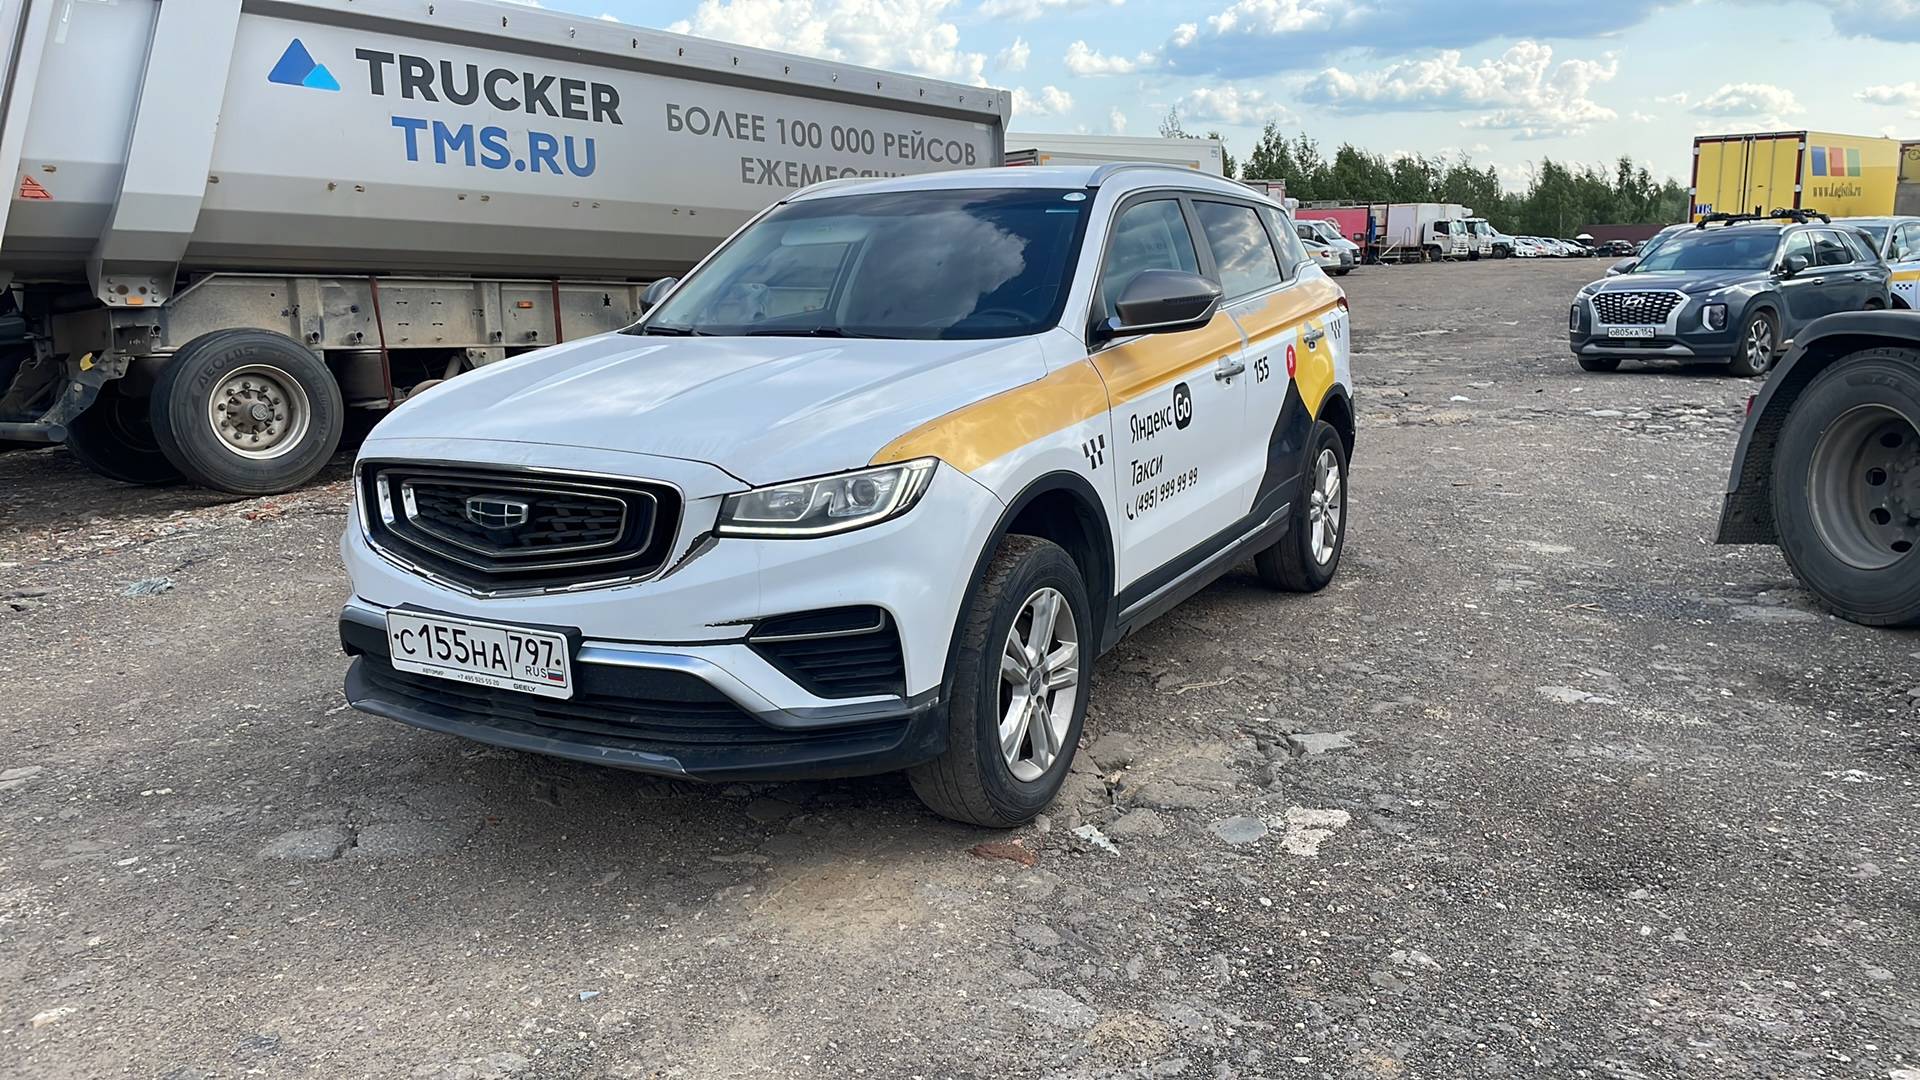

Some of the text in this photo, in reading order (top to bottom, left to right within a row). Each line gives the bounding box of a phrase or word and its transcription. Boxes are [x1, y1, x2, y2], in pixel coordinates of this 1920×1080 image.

[354, 47, 624, 125] TRUCKER
[391, 115, 597, 178] TMS.RU
[665, 103, 977, 167] БОЛЕЕ 100 000 РЕЙСОВ
[1253, 355, 1270, 384] 155
[1129, 392, 1193, 444] Яндекс Go
[1131, 454, 1164, 487] Такси
[1135, 467, 1198, 517] (495) 999 99 99
[509, 635, 553, 668] 797
[525, 665, 548, 678] RUS
[513, 683, 536, 693] GEELY
